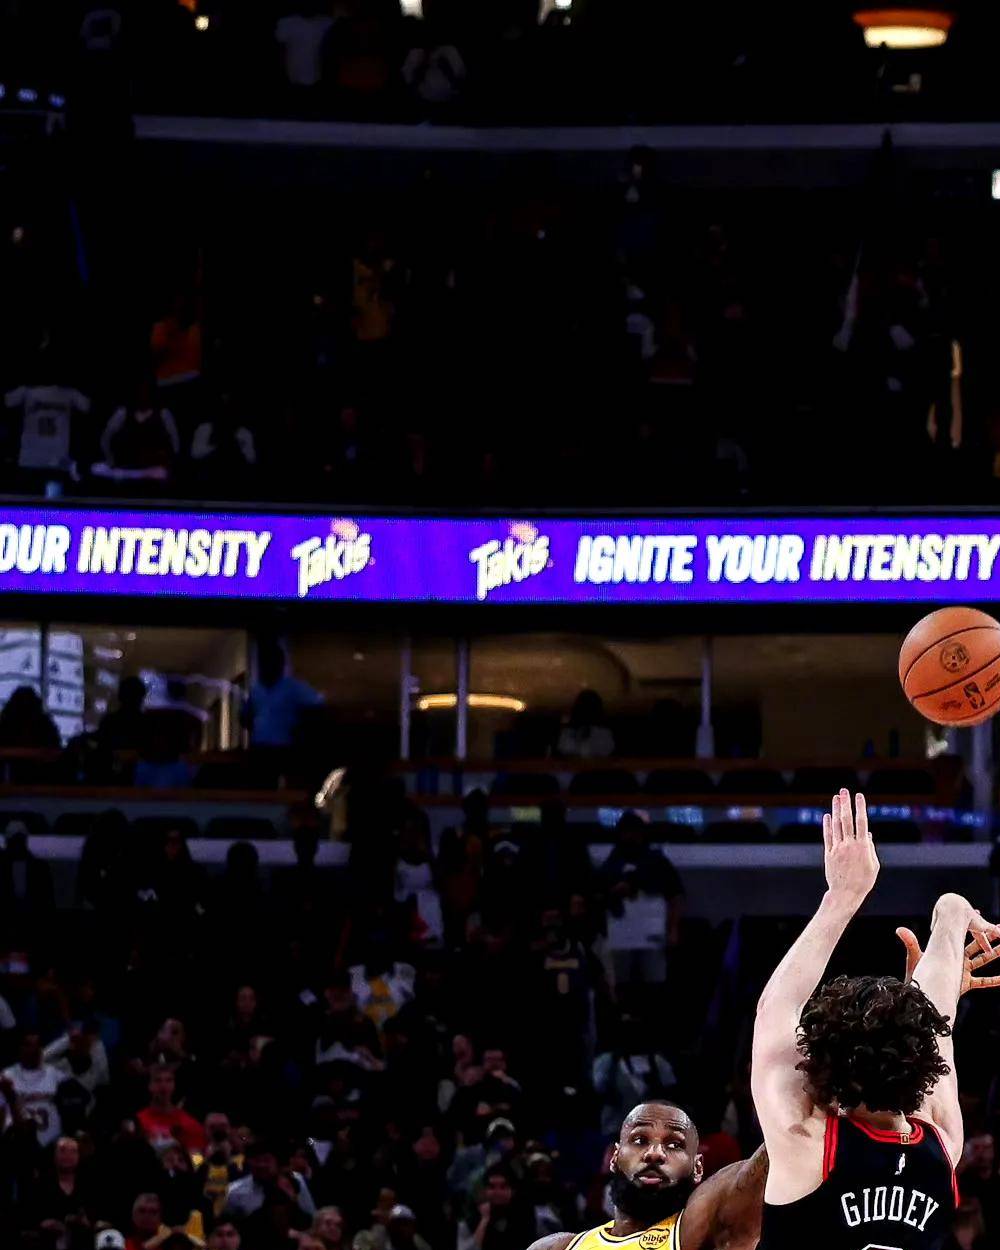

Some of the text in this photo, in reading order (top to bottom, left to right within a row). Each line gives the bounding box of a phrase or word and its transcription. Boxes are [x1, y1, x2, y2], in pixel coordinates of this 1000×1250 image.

[77, 526, 272, 577] INTENSITY
[290, 533, 371, 598] Takis
[469, 535, 549, 600] Takis
[574, 535, 698, 584] IGNITE
[706, 535, 804, 584] YOUR
[841, 1186, 939, 1232] GIDDEY
